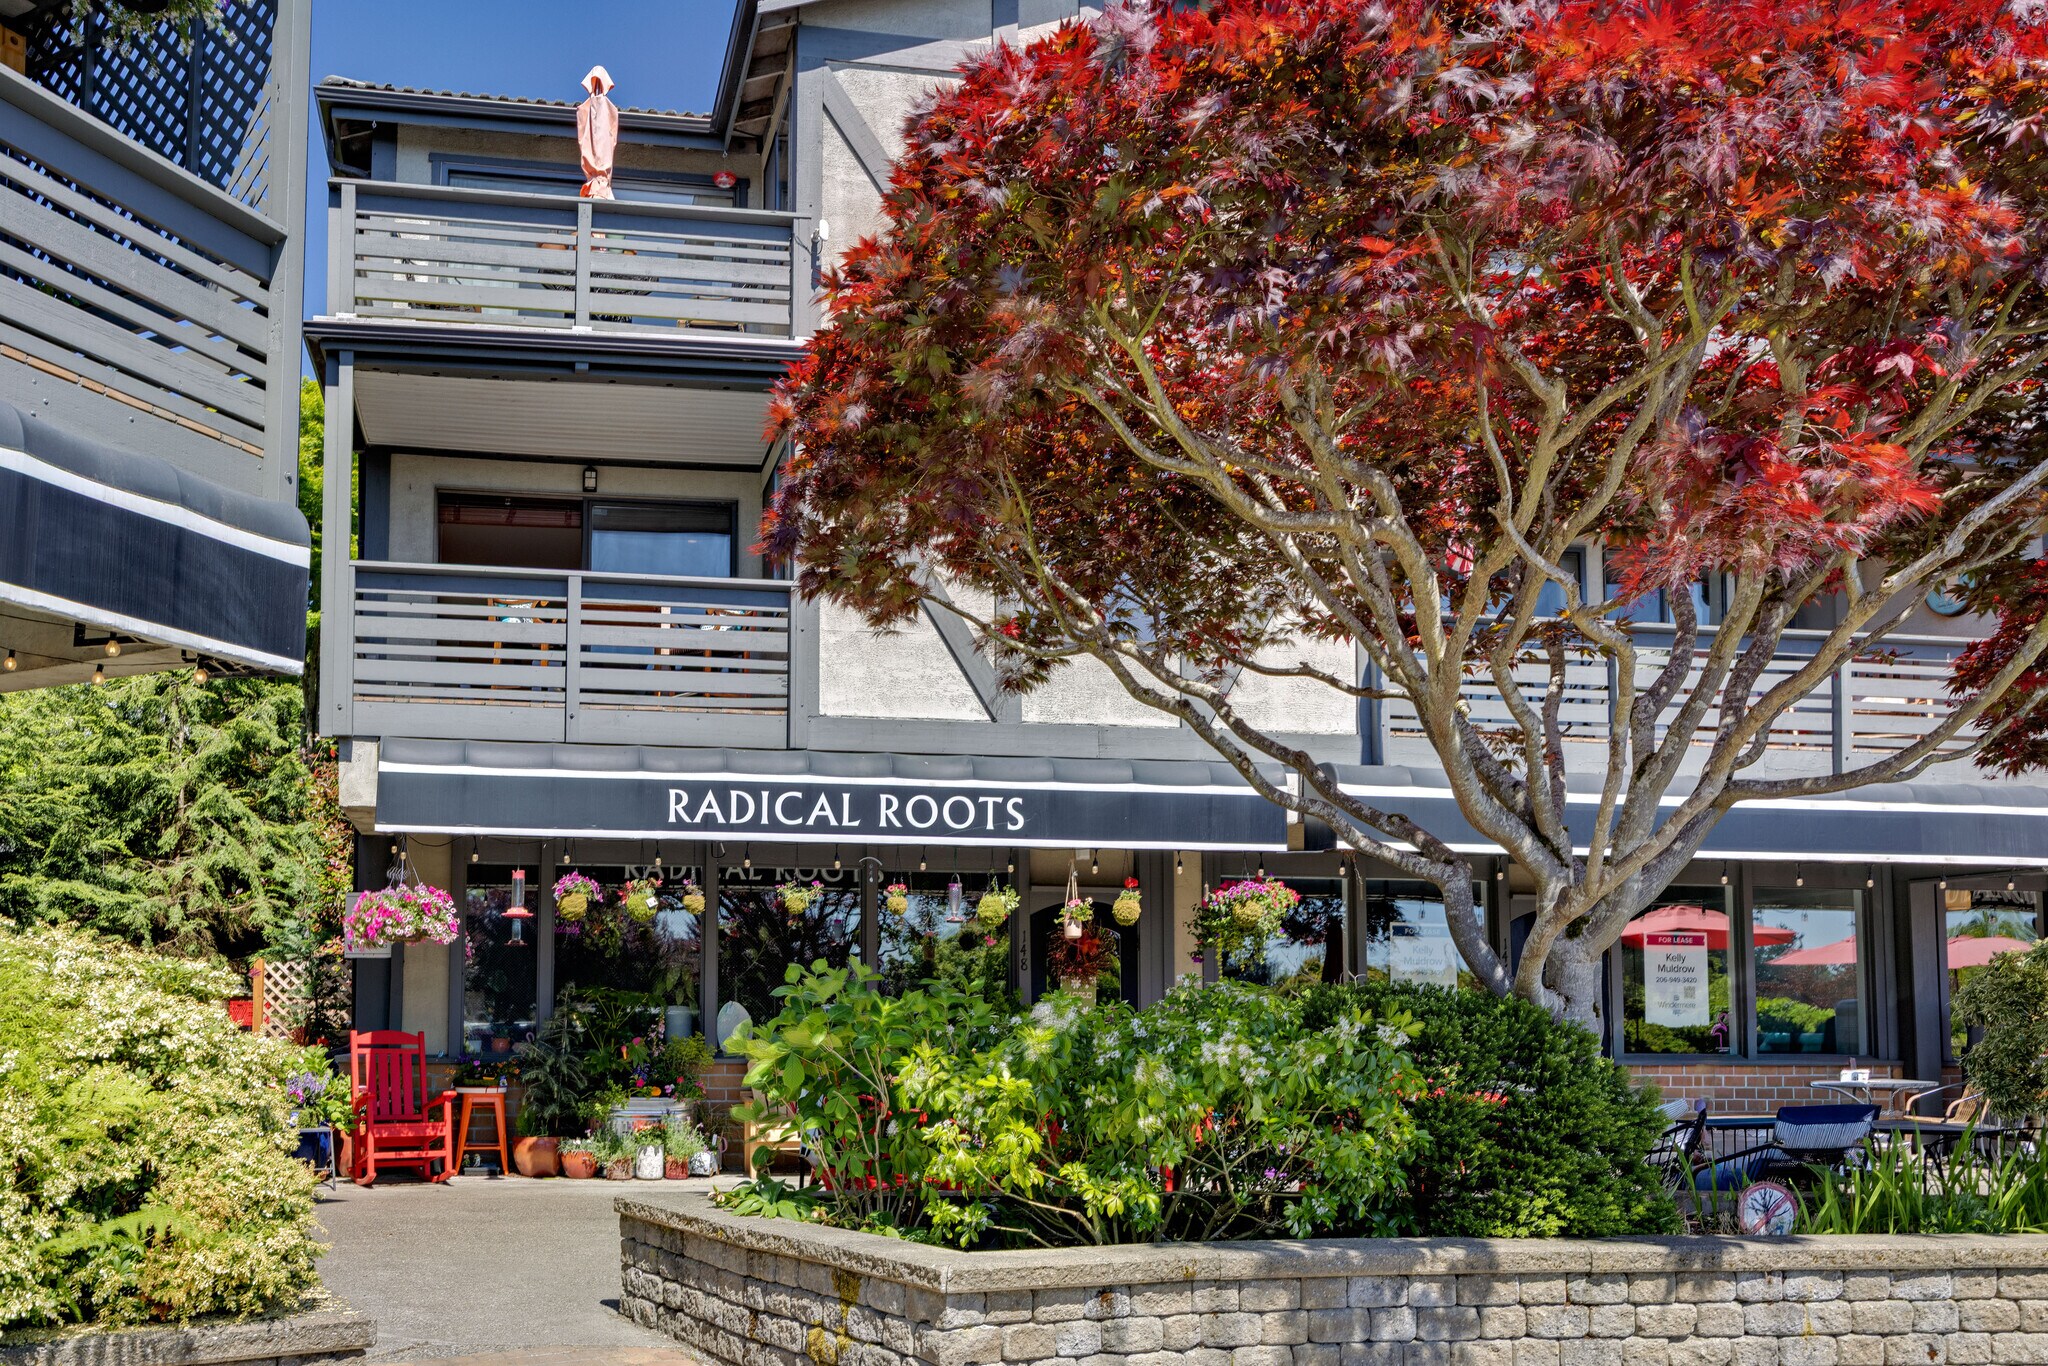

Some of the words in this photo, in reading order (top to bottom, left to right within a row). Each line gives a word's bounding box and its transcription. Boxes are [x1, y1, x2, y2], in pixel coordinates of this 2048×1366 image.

[667, 788, 862, 827] RADICAL
[878, 793, 1026, 831] ROOTS
[623, 865, 763, 881] RADIAL
[1658, 936, 1672, 944] FOR
[1673, 936, 1694, 945] LEASE
[1019, 930, 1029, 971] 148
[1412, 944, 1434, 957] Kelly
[1665, 952, 1687, 964] Kelly
[1657, 963, 1695, 973] Muldrow
[1655, 976, 1698, 984] 206-949-3420
